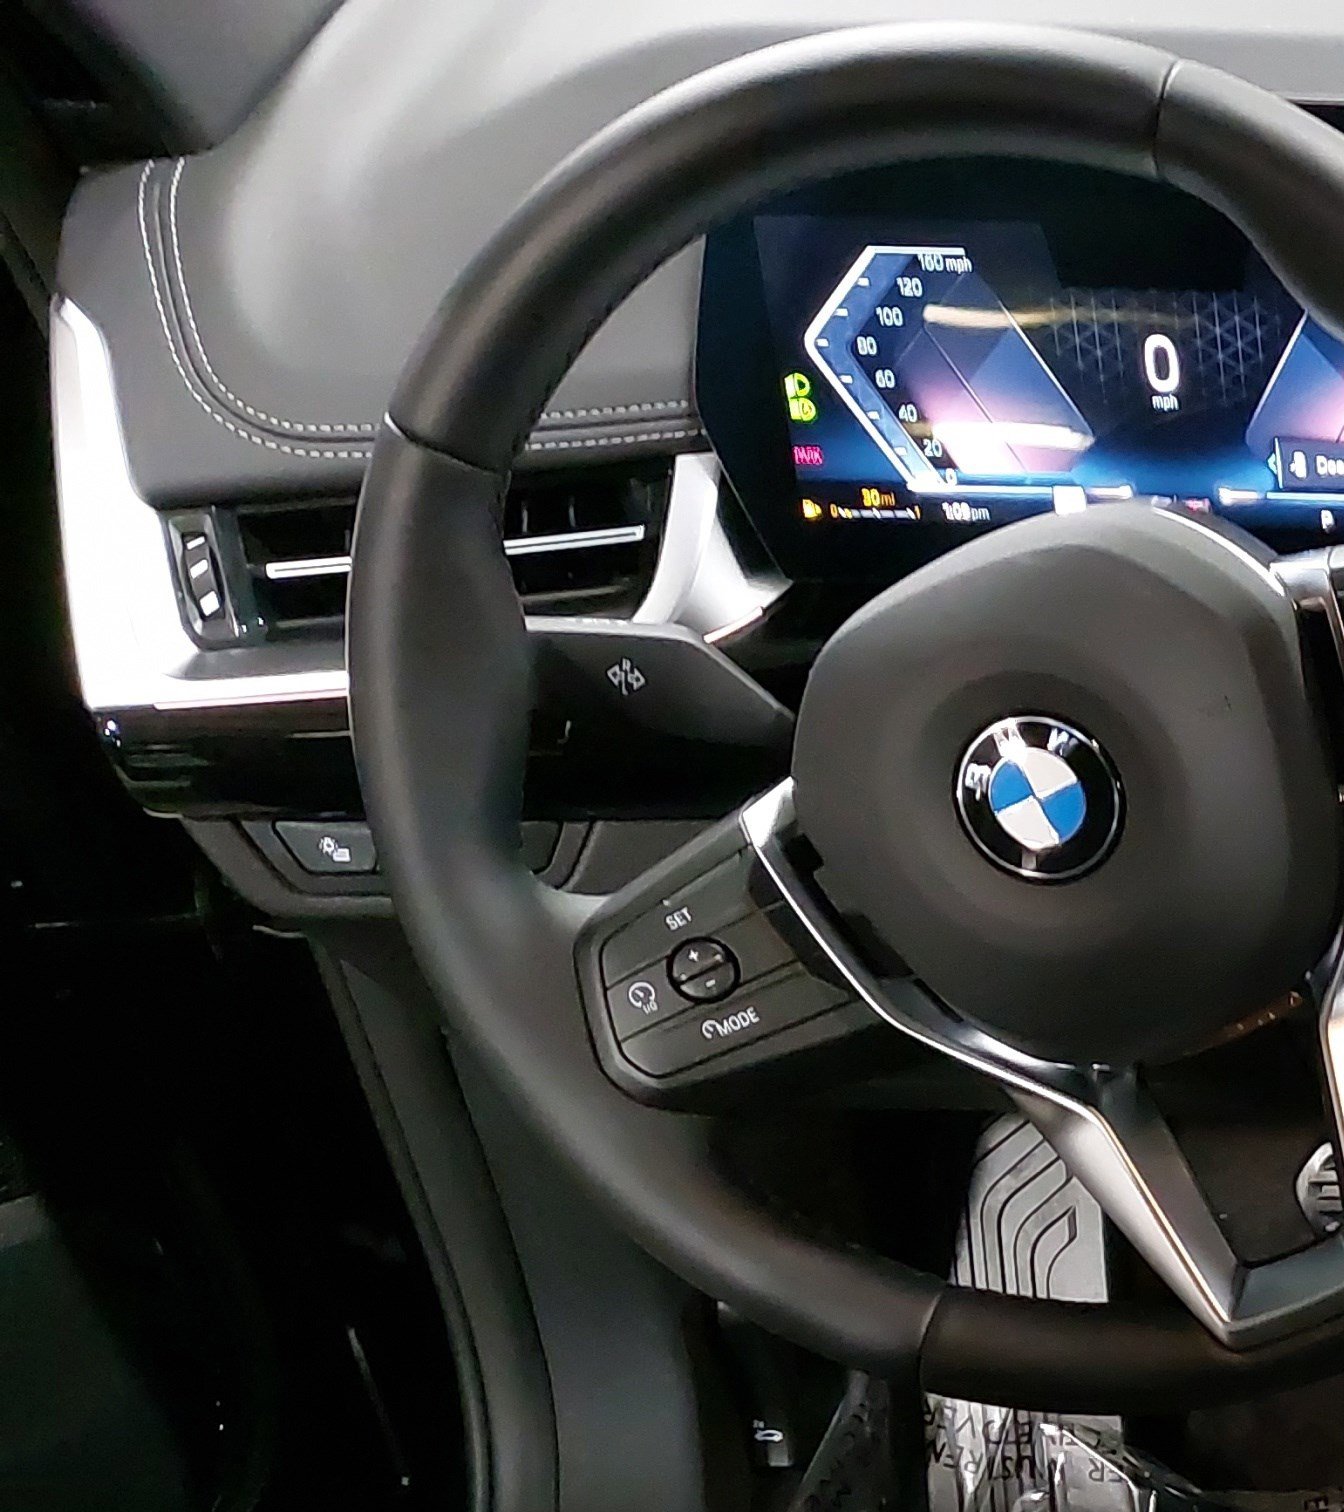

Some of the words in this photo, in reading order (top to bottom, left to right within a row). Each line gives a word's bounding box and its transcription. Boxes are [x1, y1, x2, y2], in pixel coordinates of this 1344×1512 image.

[945, 256, 973, 275] mph
[896, 276, 923, 298] 120
[875, 306, 904, 328] 100
[856, 336, 878, 356] 80
[1144, 333, 1181, 394] 0
[898, 403, 919, 423] 40
[1151, 393, 1180, 414] mph
[922, 438, 943, 458] 20
[664, 906, 693, 932] SET
[714, 1005, 761, 1038] MODE
